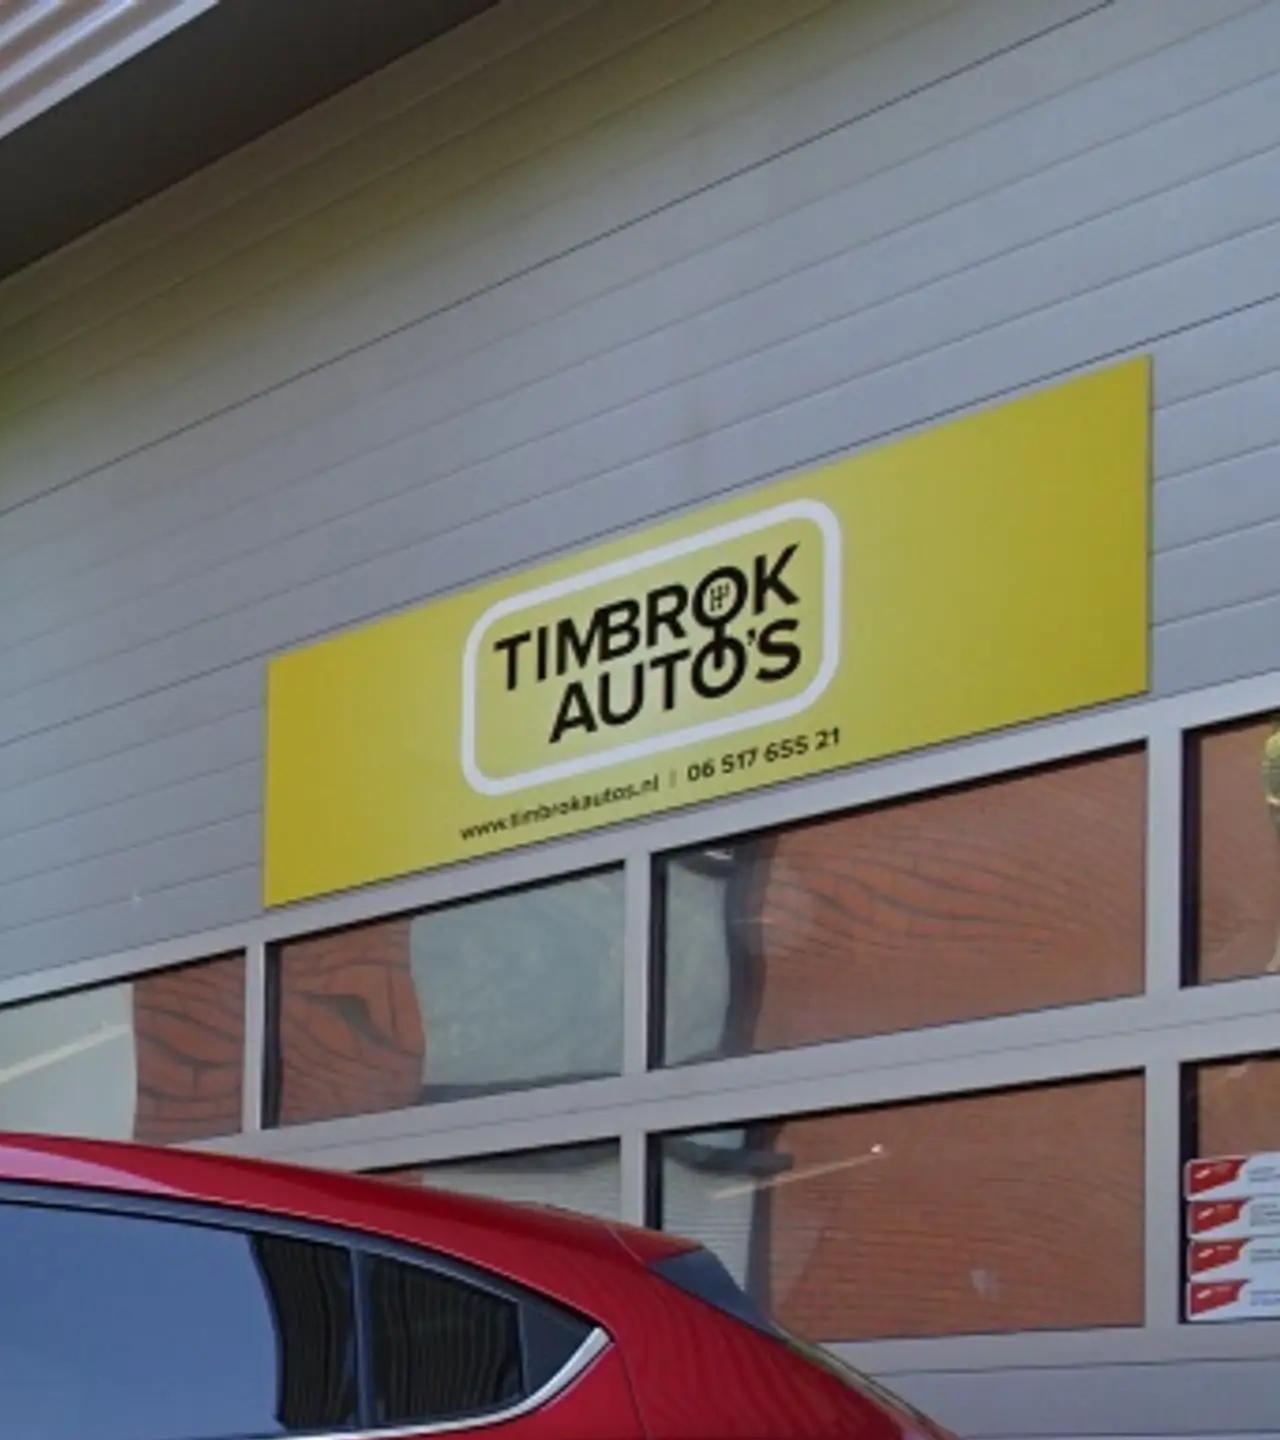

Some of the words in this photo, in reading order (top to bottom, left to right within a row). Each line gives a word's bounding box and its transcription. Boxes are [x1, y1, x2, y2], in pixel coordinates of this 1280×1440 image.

[493, 542, 800, 691] TIMBROK
[549, 618, 801, 744] AUTO'S
[460, 773, 659, 841] www.timbrokautos.nl
[687, 758, 715, 782] 06
[721, 747, 759, 775] 517
[764, 735, 808, 763] 655
[815, 727, 840, 751] 21
